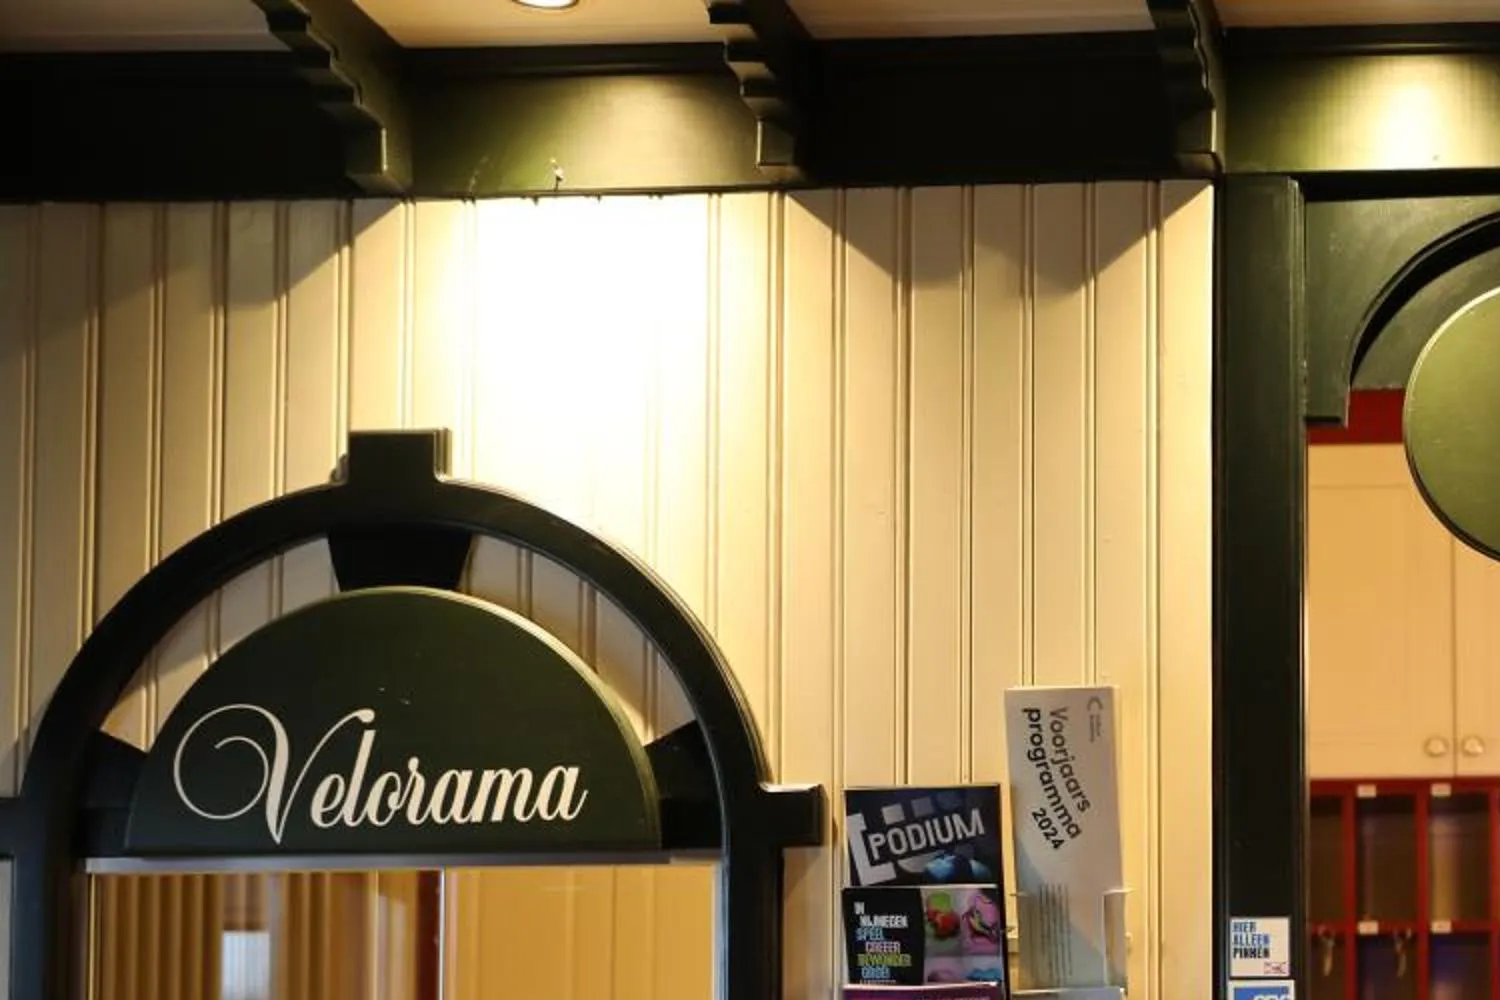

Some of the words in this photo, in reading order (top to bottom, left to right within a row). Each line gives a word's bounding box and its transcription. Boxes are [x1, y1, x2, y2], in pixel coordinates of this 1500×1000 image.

[174, 704, 588, 845] Velorama
[1022, 707, 1082, 838] programma
[1050, 706, 1091, 813] Voorjaars
[867, 808, 985, 861] PODIUM
[1032, 807, 1065, 850] 2024
[1233, 947, 1270, 959] PINNEN
